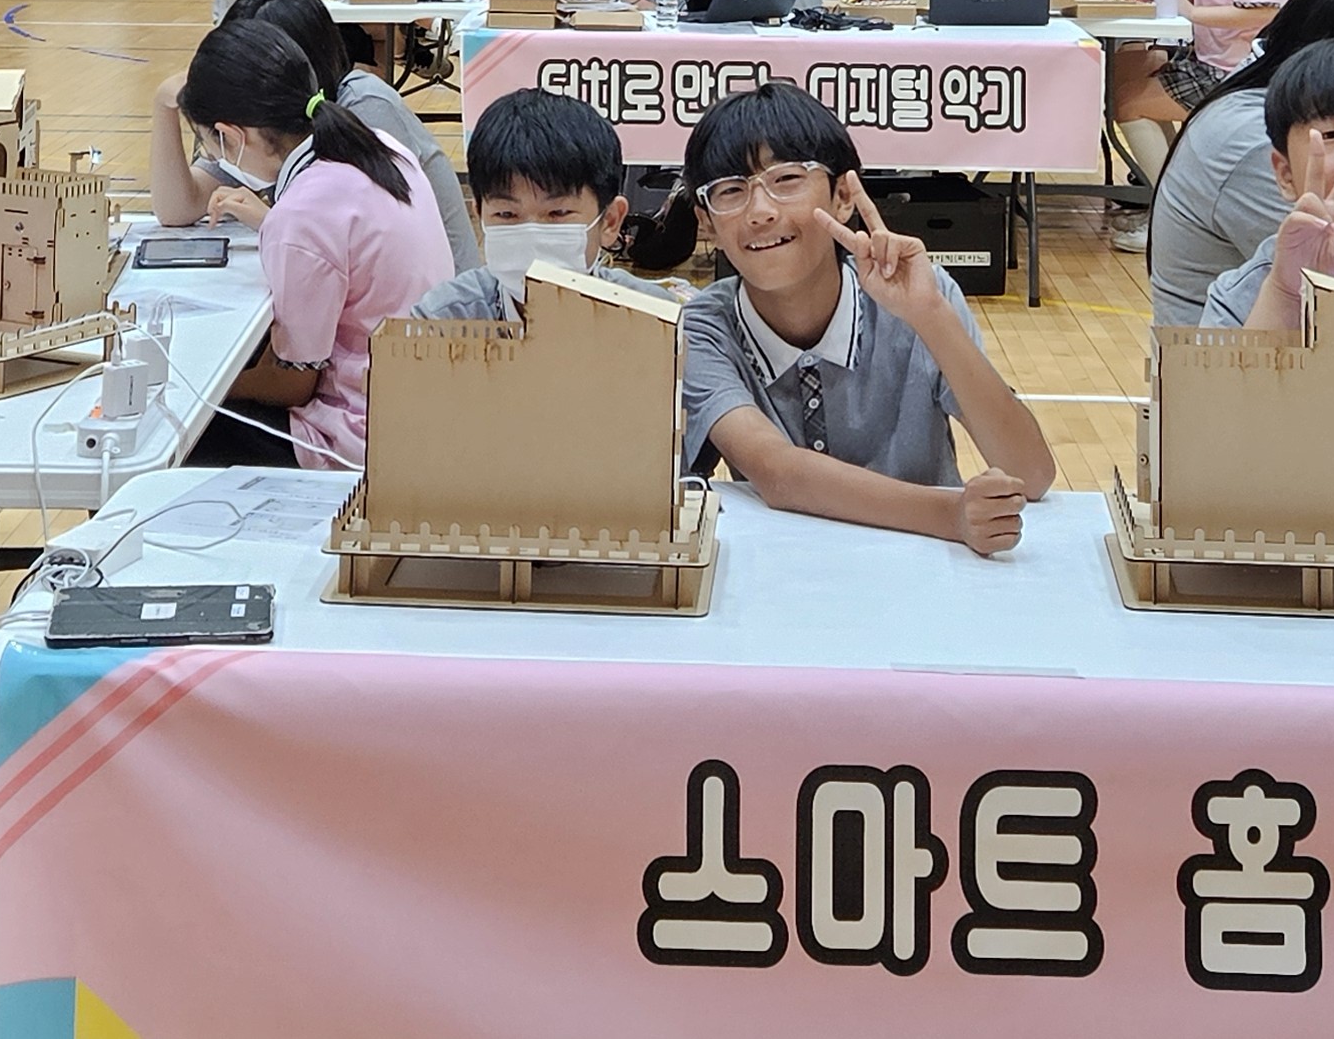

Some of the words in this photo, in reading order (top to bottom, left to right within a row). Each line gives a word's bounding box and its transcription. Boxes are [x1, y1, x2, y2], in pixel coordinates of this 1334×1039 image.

[805, 63, 933, 132] 디지털
[941, 63, 1027, 133] 악기
[636, 758, 1105, 979] 스마트
[1176, 767, 1331, 995] 홈
